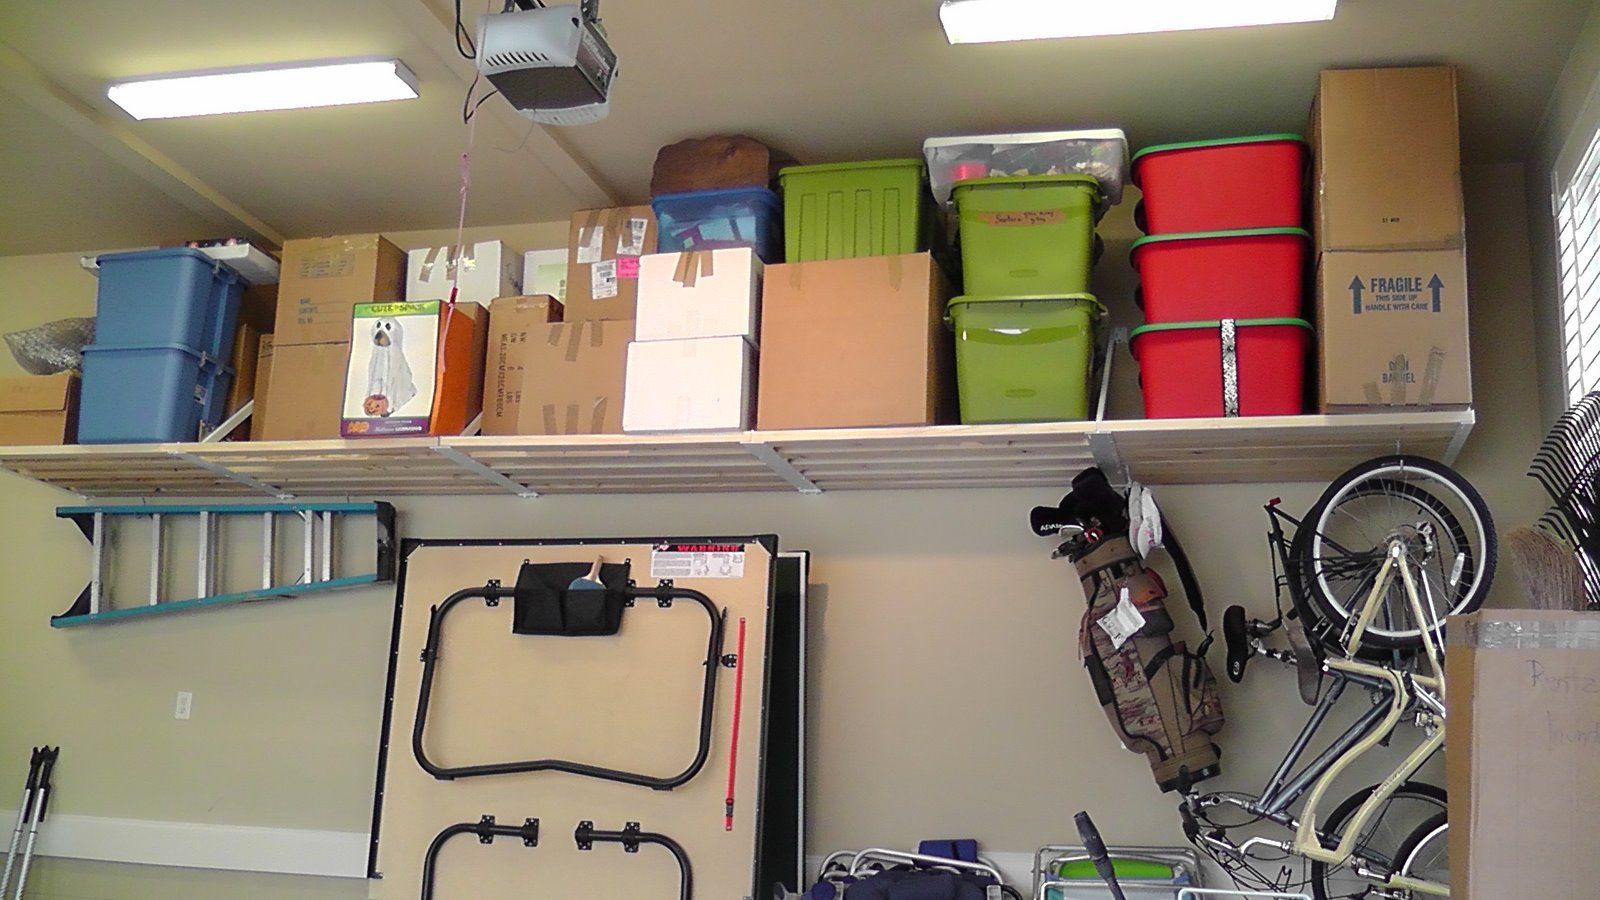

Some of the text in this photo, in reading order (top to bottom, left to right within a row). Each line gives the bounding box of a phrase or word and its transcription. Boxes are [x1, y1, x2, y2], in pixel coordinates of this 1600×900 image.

[1371, 277, 1422, 292] FRAGILE
[1366, 302, 1428, 311] HANDLE WITH CARE
[677, 544, 739, 552] WARNING
